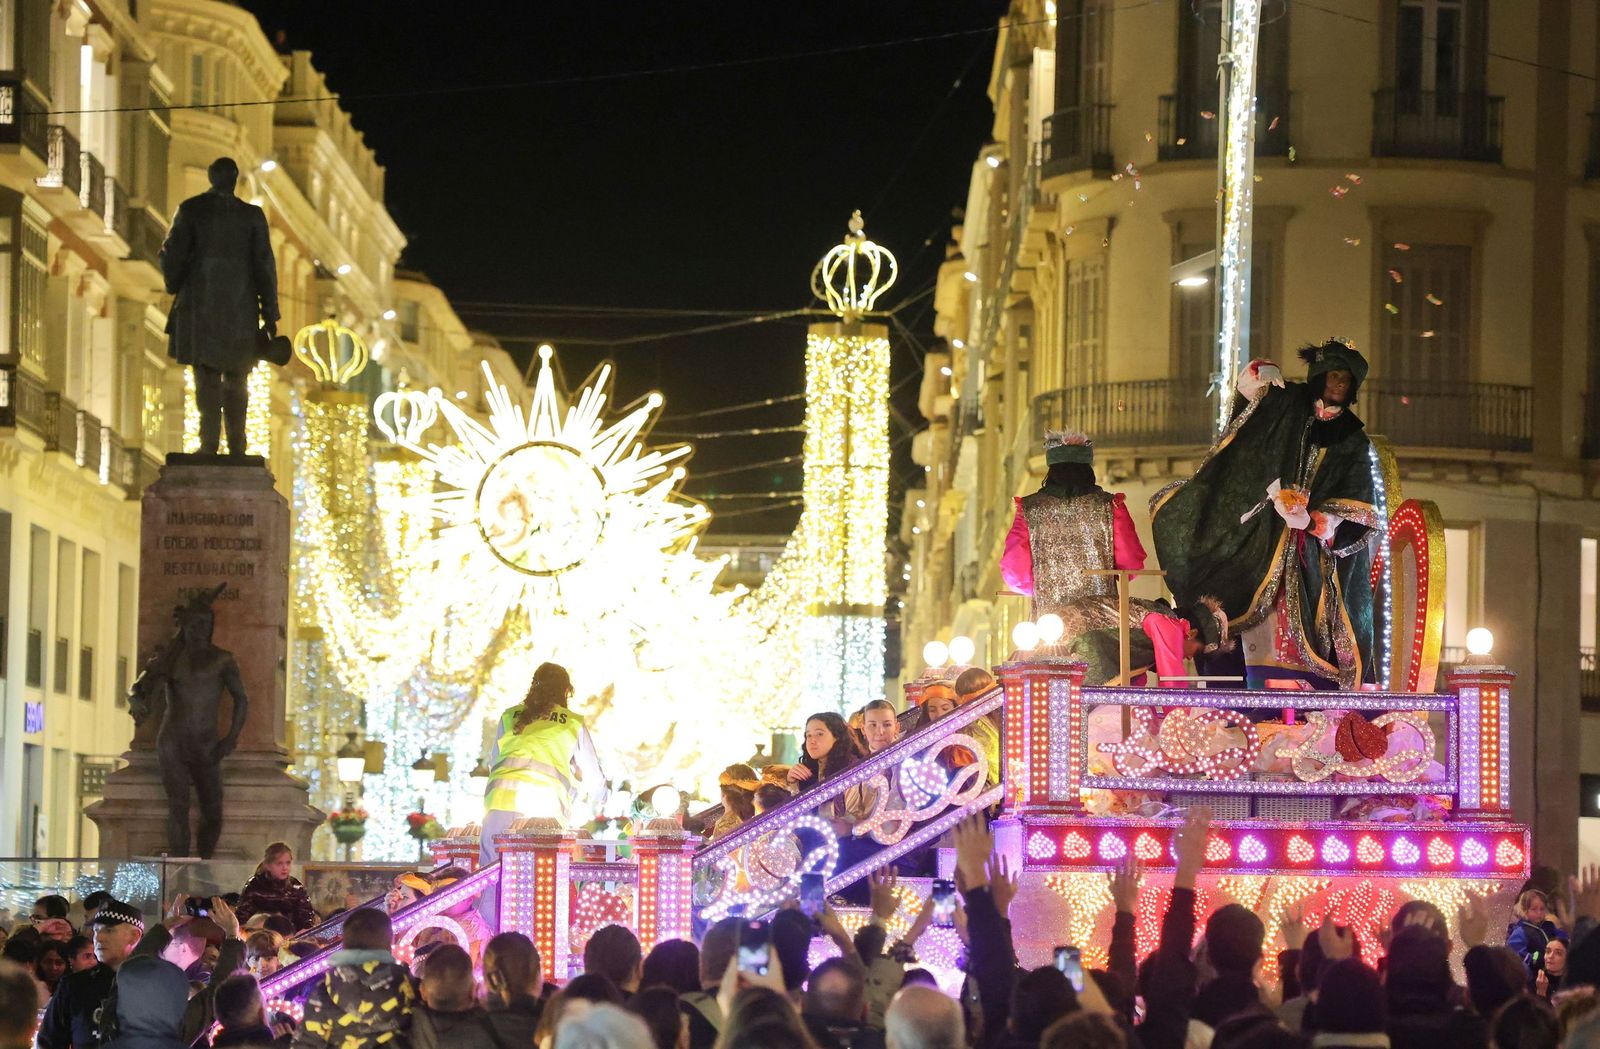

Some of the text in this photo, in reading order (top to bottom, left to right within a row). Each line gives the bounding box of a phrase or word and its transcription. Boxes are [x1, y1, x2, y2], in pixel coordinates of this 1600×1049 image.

[167, 511, 255, 526] INAUGURACION
[164, 536, 198, 550] ENERO
[163, 562, 255, 576] RESTAURACION
